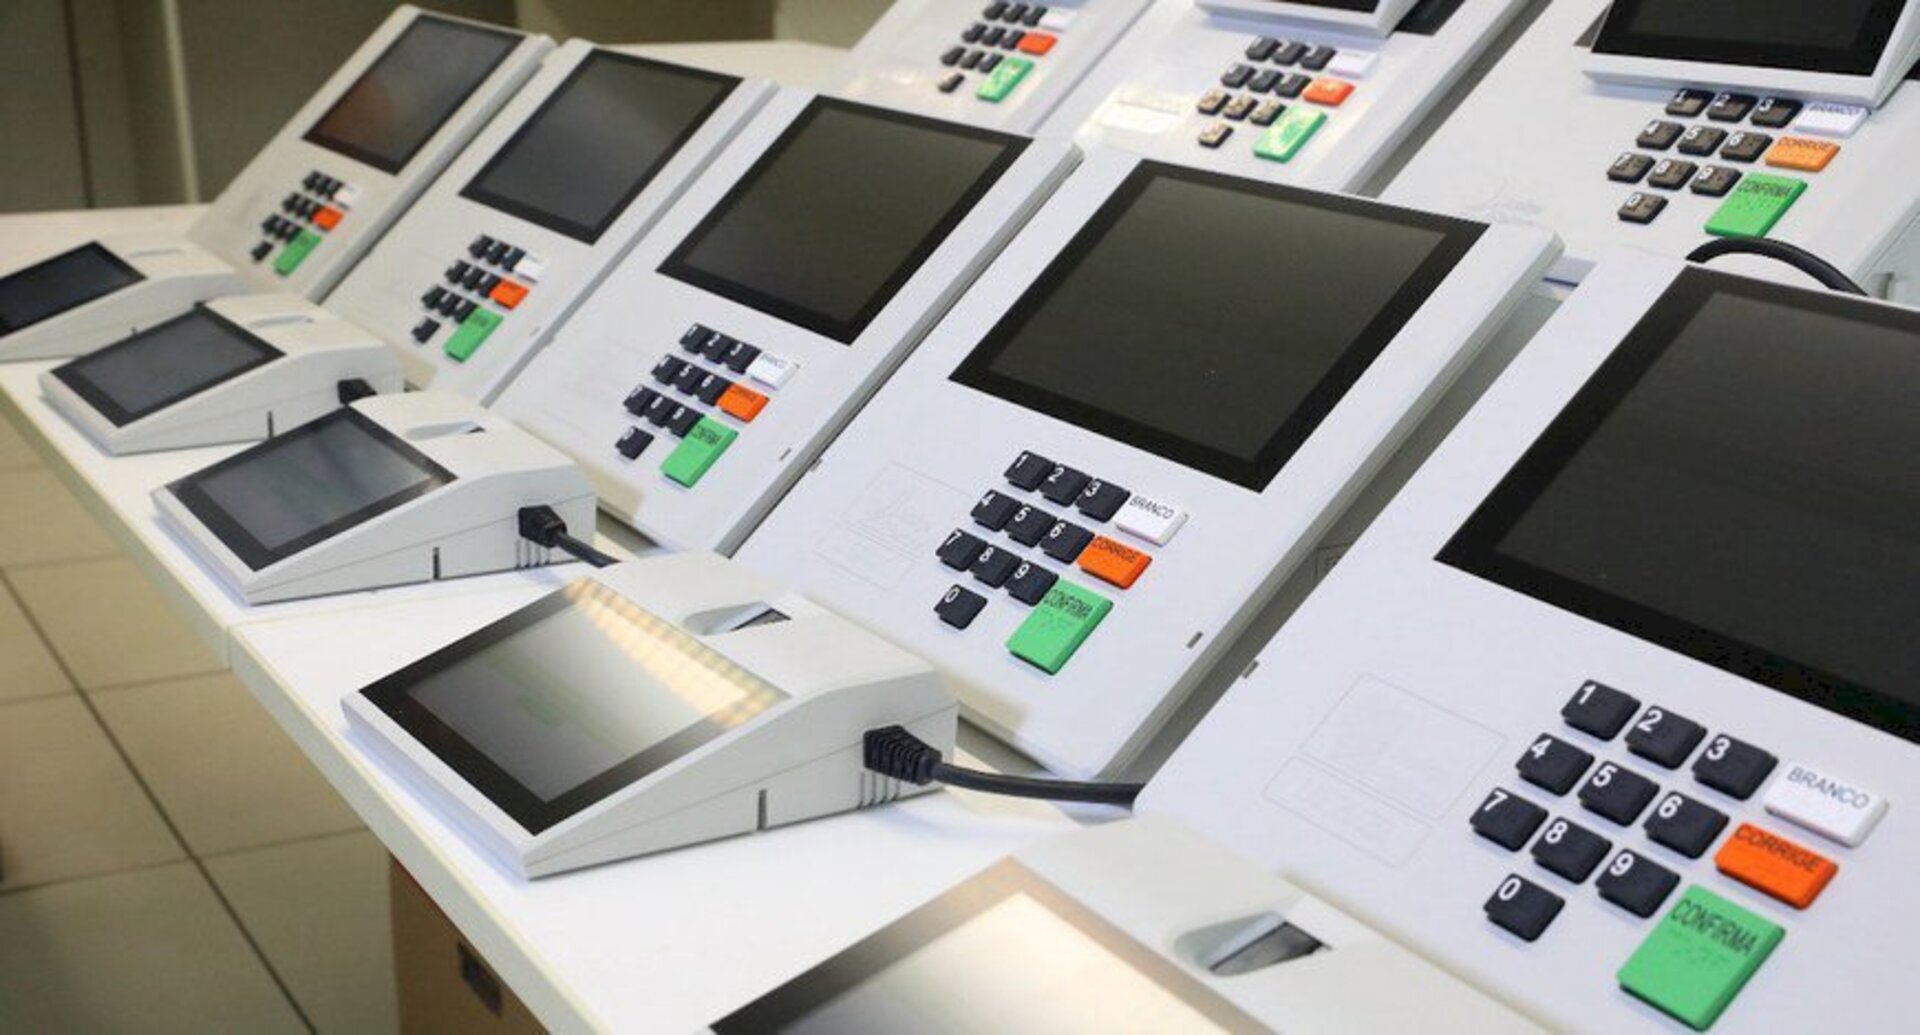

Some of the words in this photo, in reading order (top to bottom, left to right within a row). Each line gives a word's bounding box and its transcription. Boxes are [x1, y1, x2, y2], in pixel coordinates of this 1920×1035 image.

[1714, 94, 1730, 108] 2
[1685, 126, 1702, 140] 5
[1015, 454, 1028, 469] 1
[1048, 467, 1065, 483] 2
[1085, 481, 1102, 497] 3
[1129, 495, 1175, 520] BRANCO
[946, 531, 962, 546] 7
[1050, 522, 1067, 538] 6
[978, 546, 995, 563] 8
[1014, 563, 1031, 580] 9
[944, 586, 961, 604] 0
[1580, 684, 1596, 705] 1
[1637, 709, 1662, 732] 2
[1531, 738, 1550, 759] 4
[1706, 737, 1731, 761] 3
[1592, 765, 1617, 788] 5
[1787, 765, 1870, 809] BRANCO
[1484, 791, 1508, 811] 7
[1657, 794, 1682, 819] 6
[1545, 821, 1568, 845] 8
[1734, 826, 1822, 873] CORRIGE
[1610, 852, 1634, 877] 9
[1499, 878, 1522, 901] 0
[1670, 899, 1758, 956] CONFIRMA
